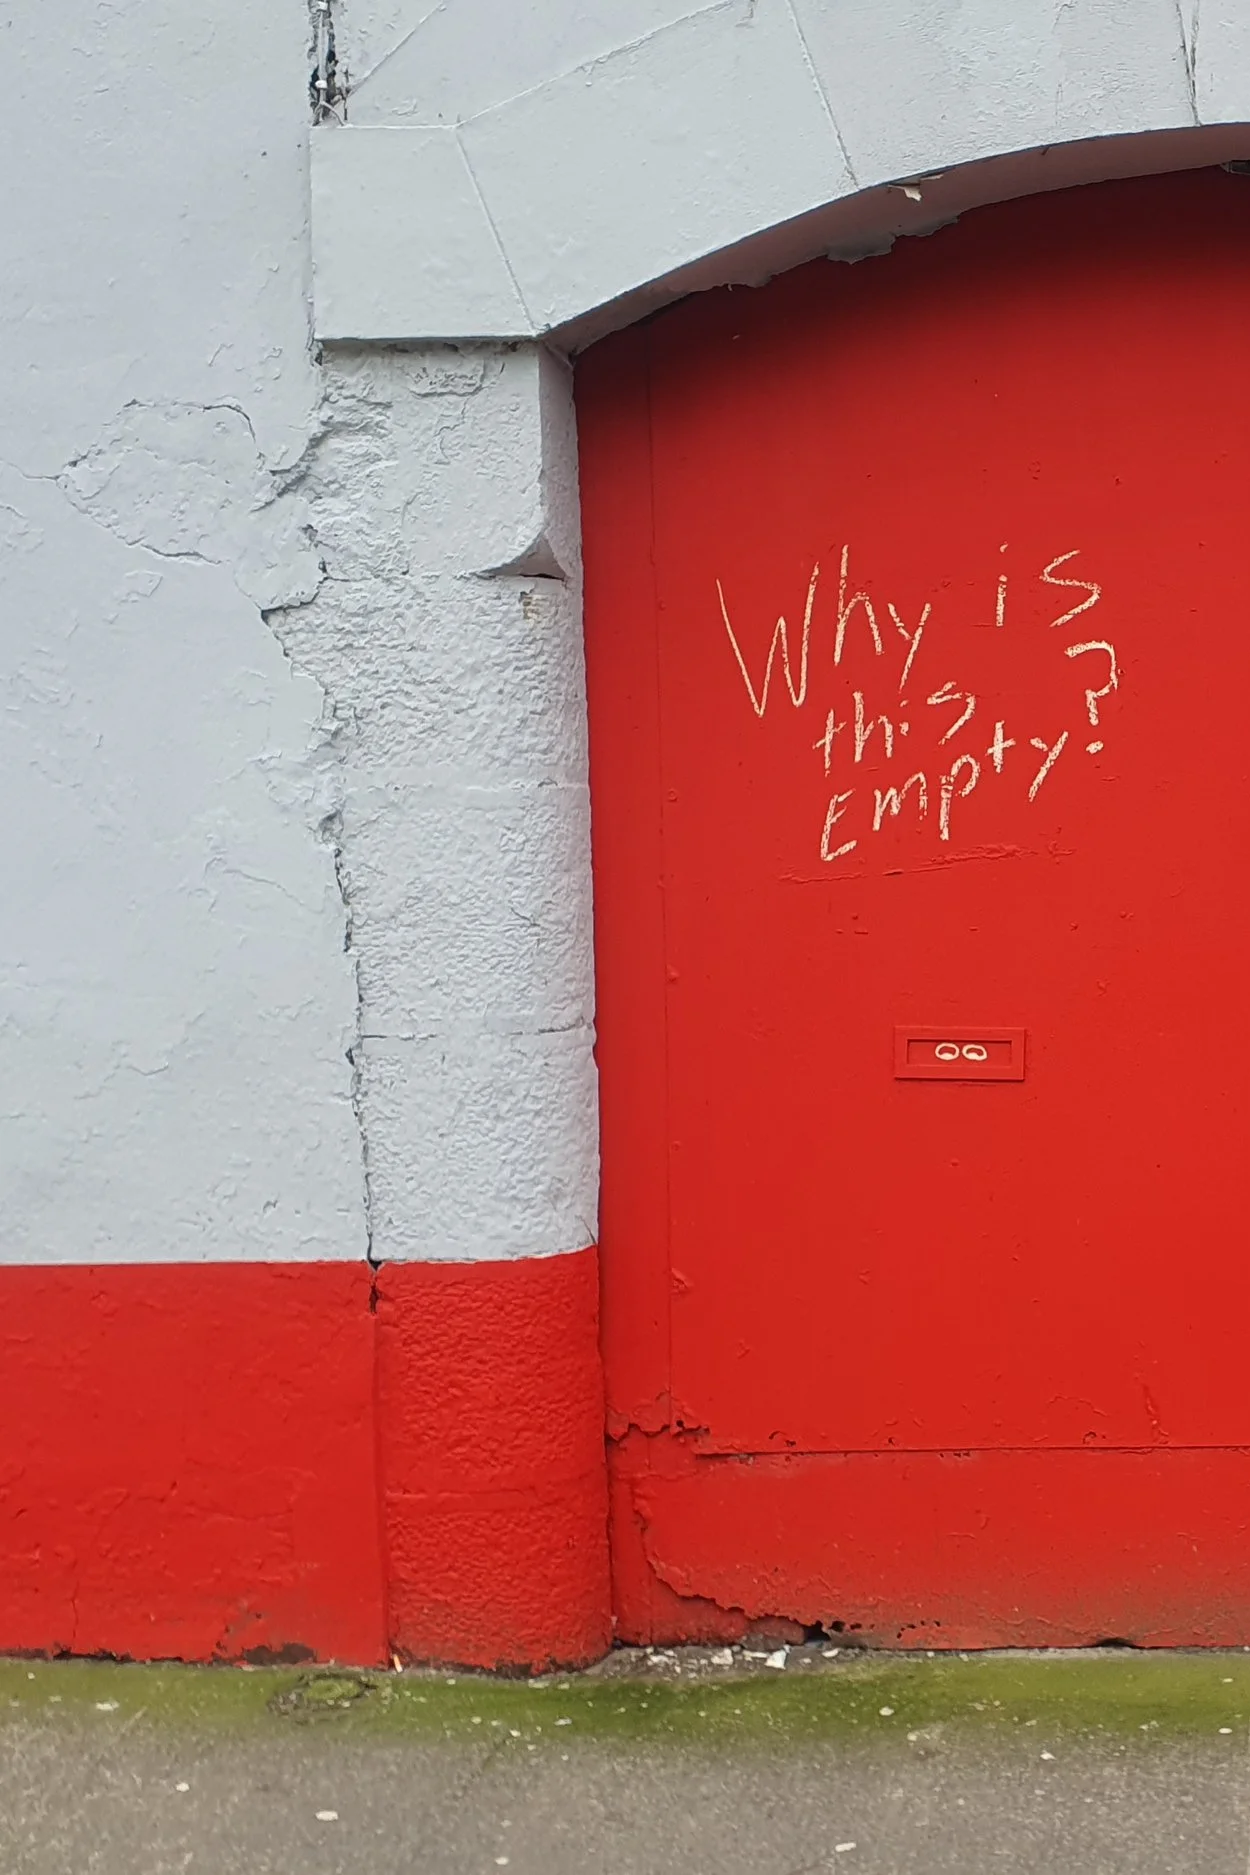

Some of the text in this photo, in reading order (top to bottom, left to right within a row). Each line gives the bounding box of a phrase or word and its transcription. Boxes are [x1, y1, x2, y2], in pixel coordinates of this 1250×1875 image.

[715, 542, 1102, 718] Why is
[812, 681, 976, 777] this
